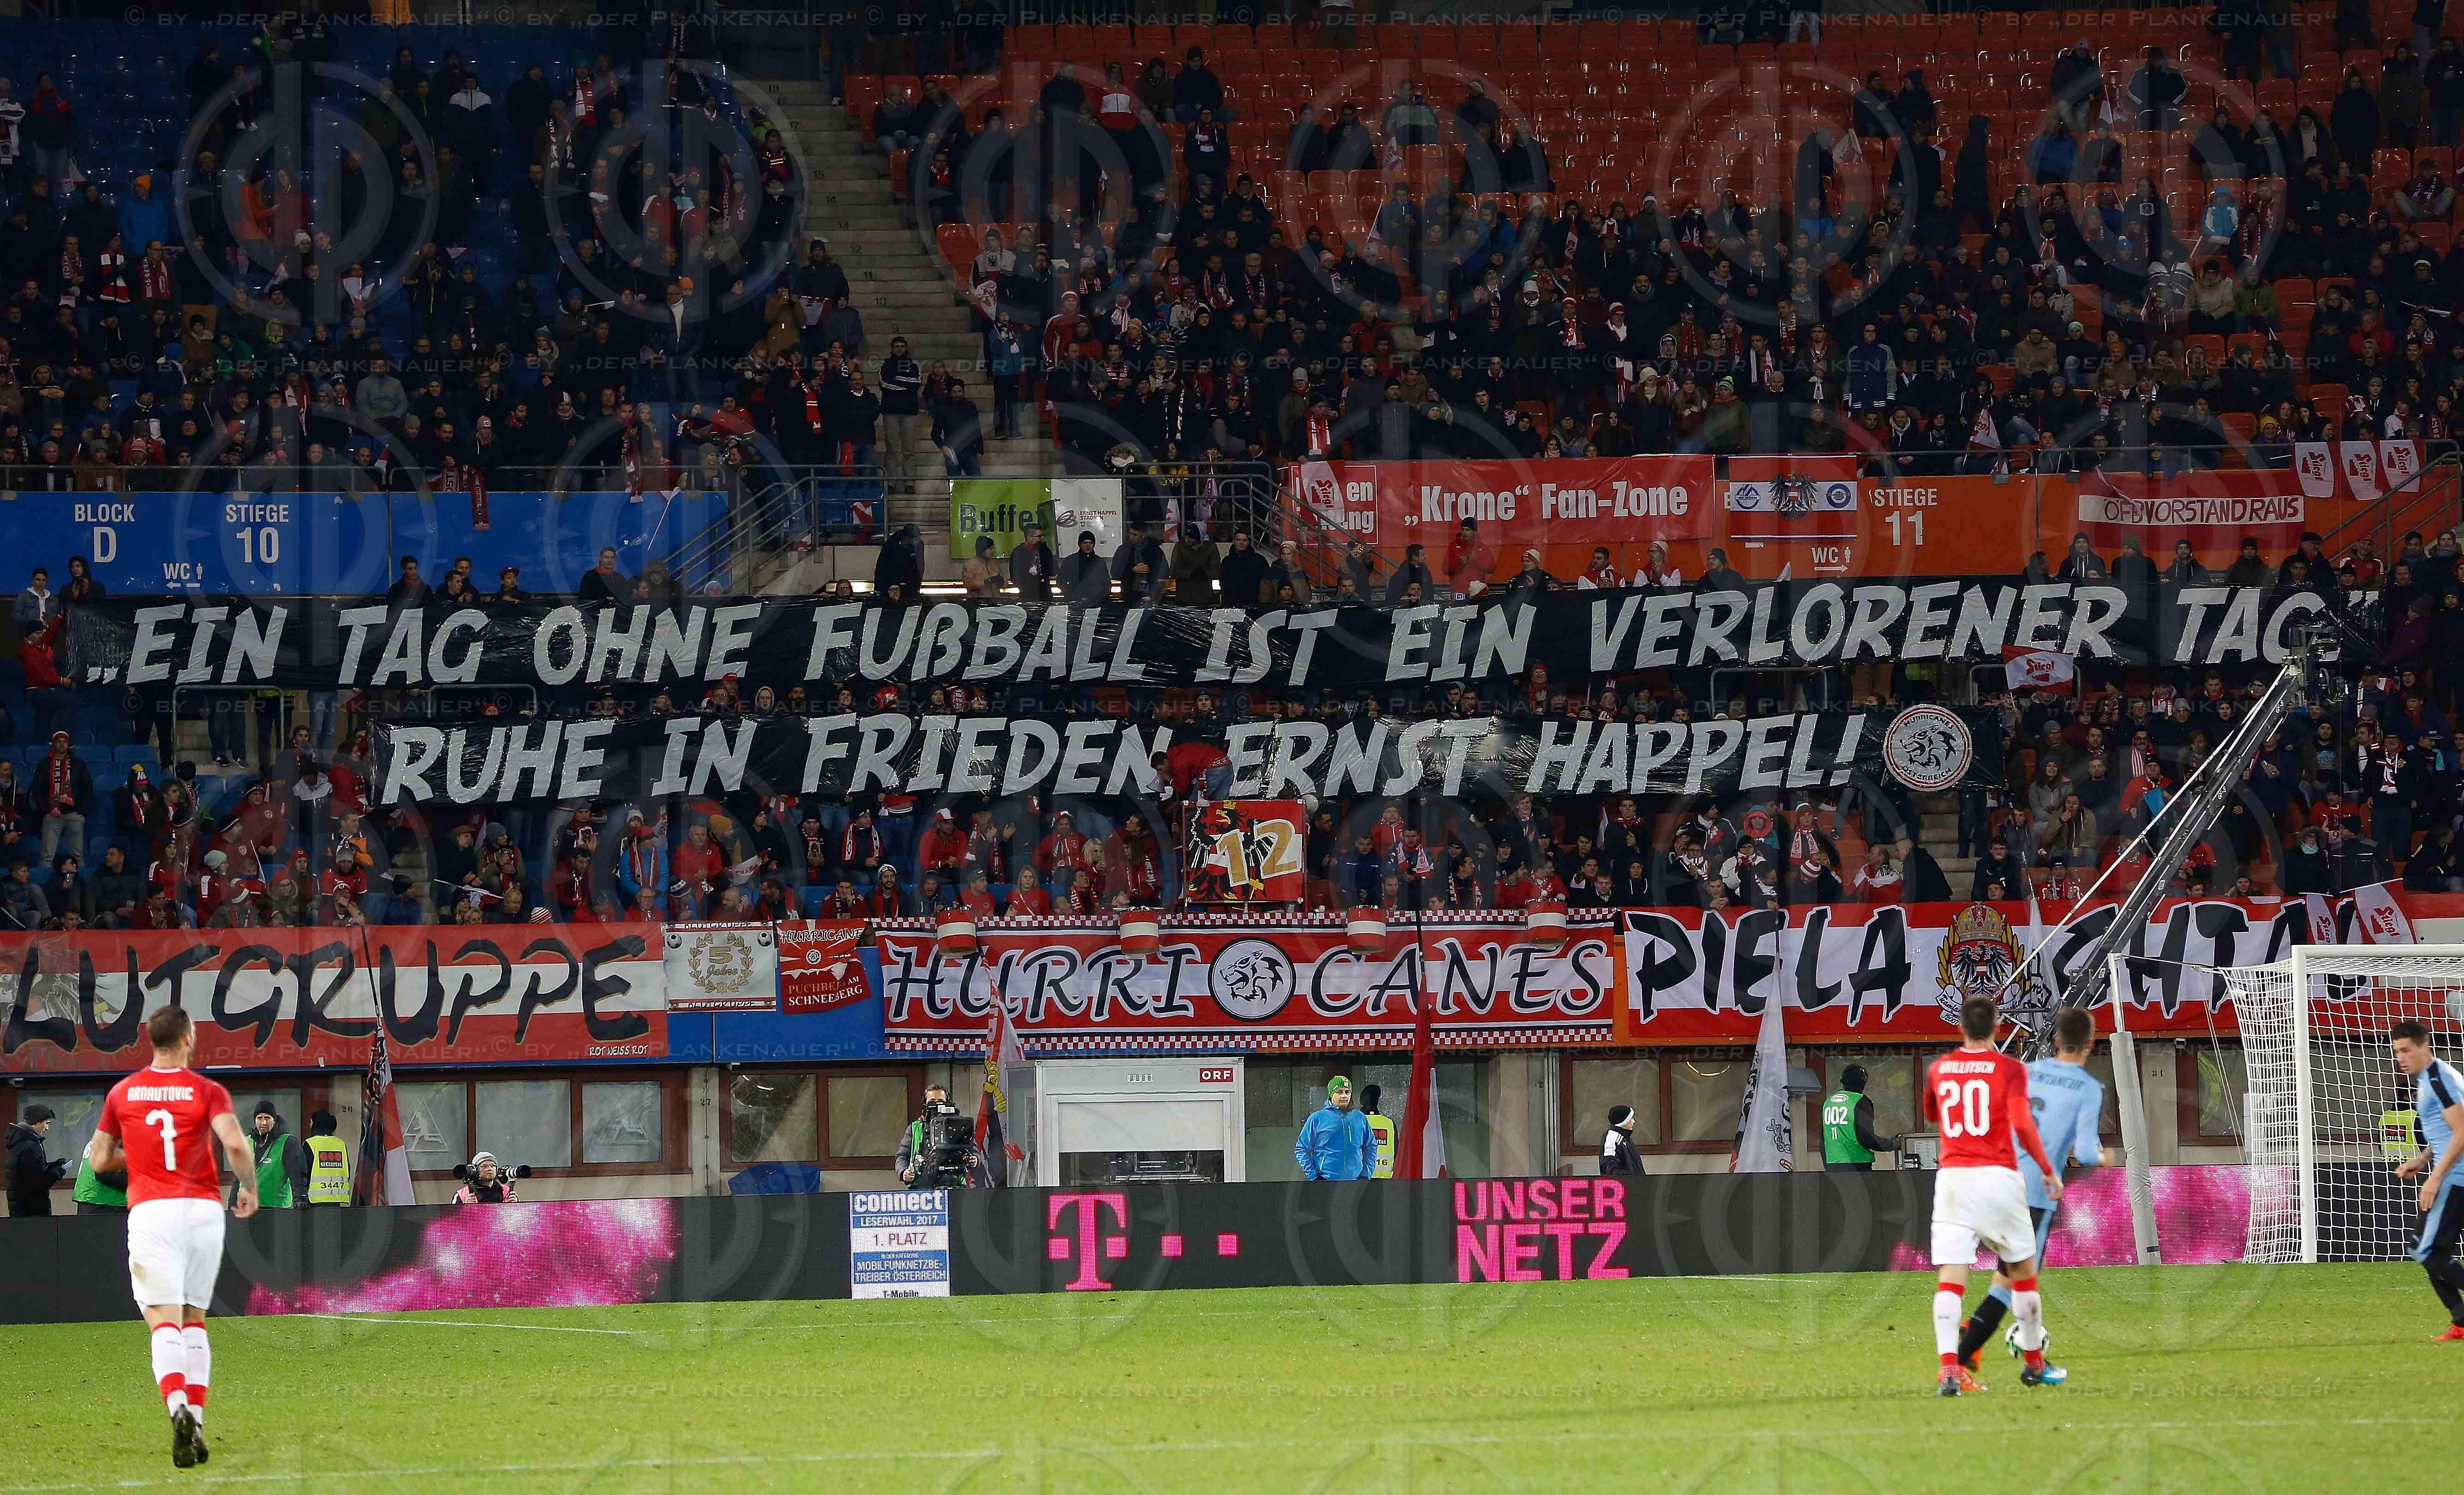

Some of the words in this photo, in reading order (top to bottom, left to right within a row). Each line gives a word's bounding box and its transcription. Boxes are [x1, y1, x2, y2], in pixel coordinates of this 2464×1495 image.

[1405, 485, 1530, 526] „Krone“
[1542, 481, 1688, 519] Fan-Zone
[1873, 488, 1938, 507] STIEGE
[74, 503, 135, 523] BLOCK
[225, 503, 289, 523] STIEGE
[960, 503, 1041, 533] Buffe
[1885, 510, 1924, 546] 11
[93, 526, 117, 563] D
[236, 527, 280, 563] 10
[1811, 546, 1839, 563] WC
[163, 562, 191, 580] WC
[338, 605, 490, 686] TAG
[533, 602, 762, 686] OHNE
[804, 602, 1146, 682] FUßBALL
[1197, 608, 1339, 688] IST
[1386, 603, 1537, 684] EIN
[1591, 581, 2128, 673] VERLORENER
[2026, 658, 2055, 676] Stiegl
[1904, 715, 1955, 730] HURRICANES
[381, 718, 616, 805] RUHE
[651, 717, 747, 797] IN
[801, 715, 1173, 797] FRIEDEN
[1225, 717, 1491, 799] ERNST
[1524, 713, 1867, 795] HAPPEL!
[1209, 818, 1302, 887] 12
[2373, 906, 2400, 937] Stiegl
[709, 946, 733, 964] 5
[848, 975, 860, 985] AM
[886, 939, 1201, 1023] HURRI
[1307, 937, 1608, 1017] CANES
[789, 984, 863, 1006] SCHNEEBERG
[589, 1046, 606, 1056] ROT
[607, 1046, 629, 1056] WEISS
[632, 1044, 648, 1054] ROT
[1202, 1070, 1231, 1080] ORF
[126, 1086, 195, 1102] ARNAUTOVIC
[1824, 1106, 1848, 1125] 002
[1938, 1078, 1990, 1138] 20
[144, 1108, 178, 1171] 7
[854, 1190, 944, 1213] connect
[1454, 1180, 1626, 1221] UNSER
[916, 1214, 939, 1225] 2017
[874, 1234, 884, 1246] 1.
[888, 1232, 927, 1246] PLATZ
[1456, 1221, 1630, 1283] NETZ
